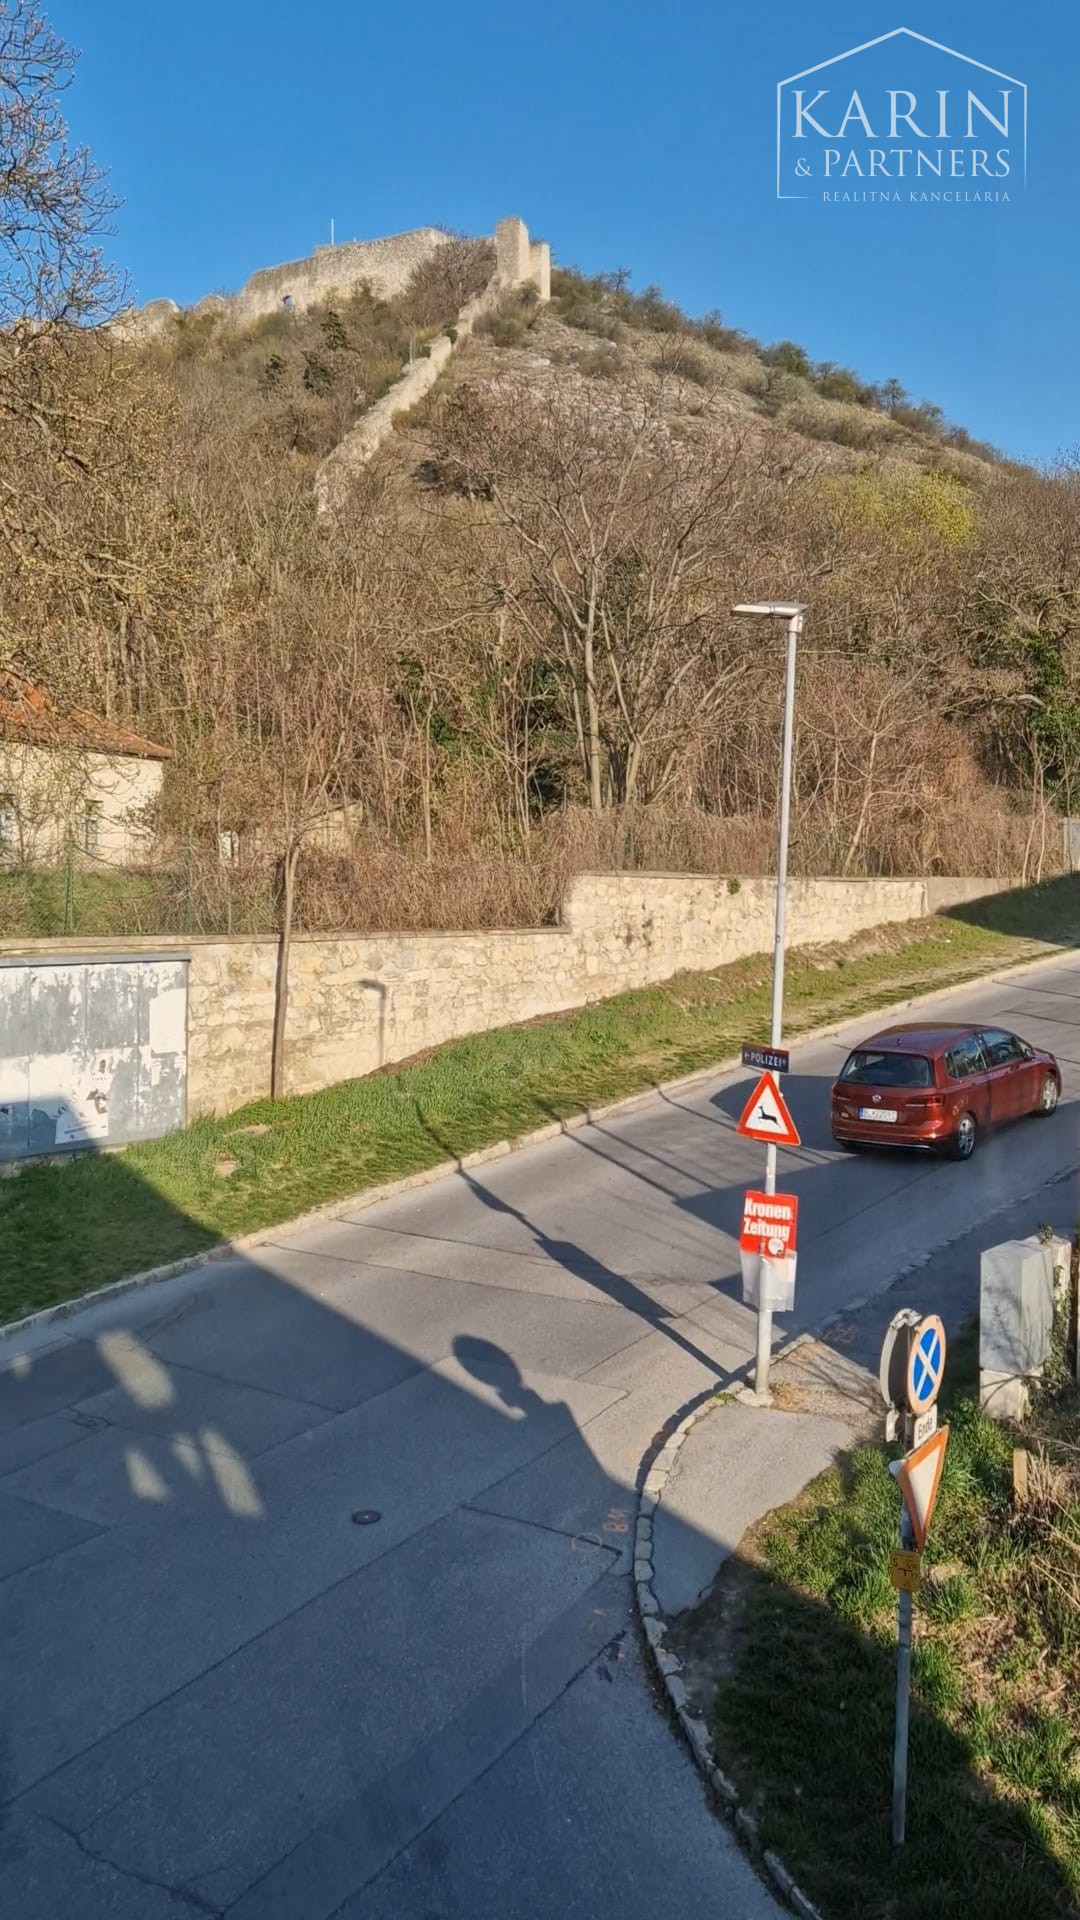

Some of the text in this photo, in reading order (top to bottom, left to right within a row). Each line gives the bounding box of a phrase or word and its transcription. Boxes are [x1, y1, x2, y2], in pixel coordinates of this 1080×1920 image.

[750, 1052, 782, 1068] POLIZEI
[744, 1197, 792, 1220] Kronen
[743, 1216, 791, 1242] Zeitung
[918, 1416, 933, 1441] Ende
